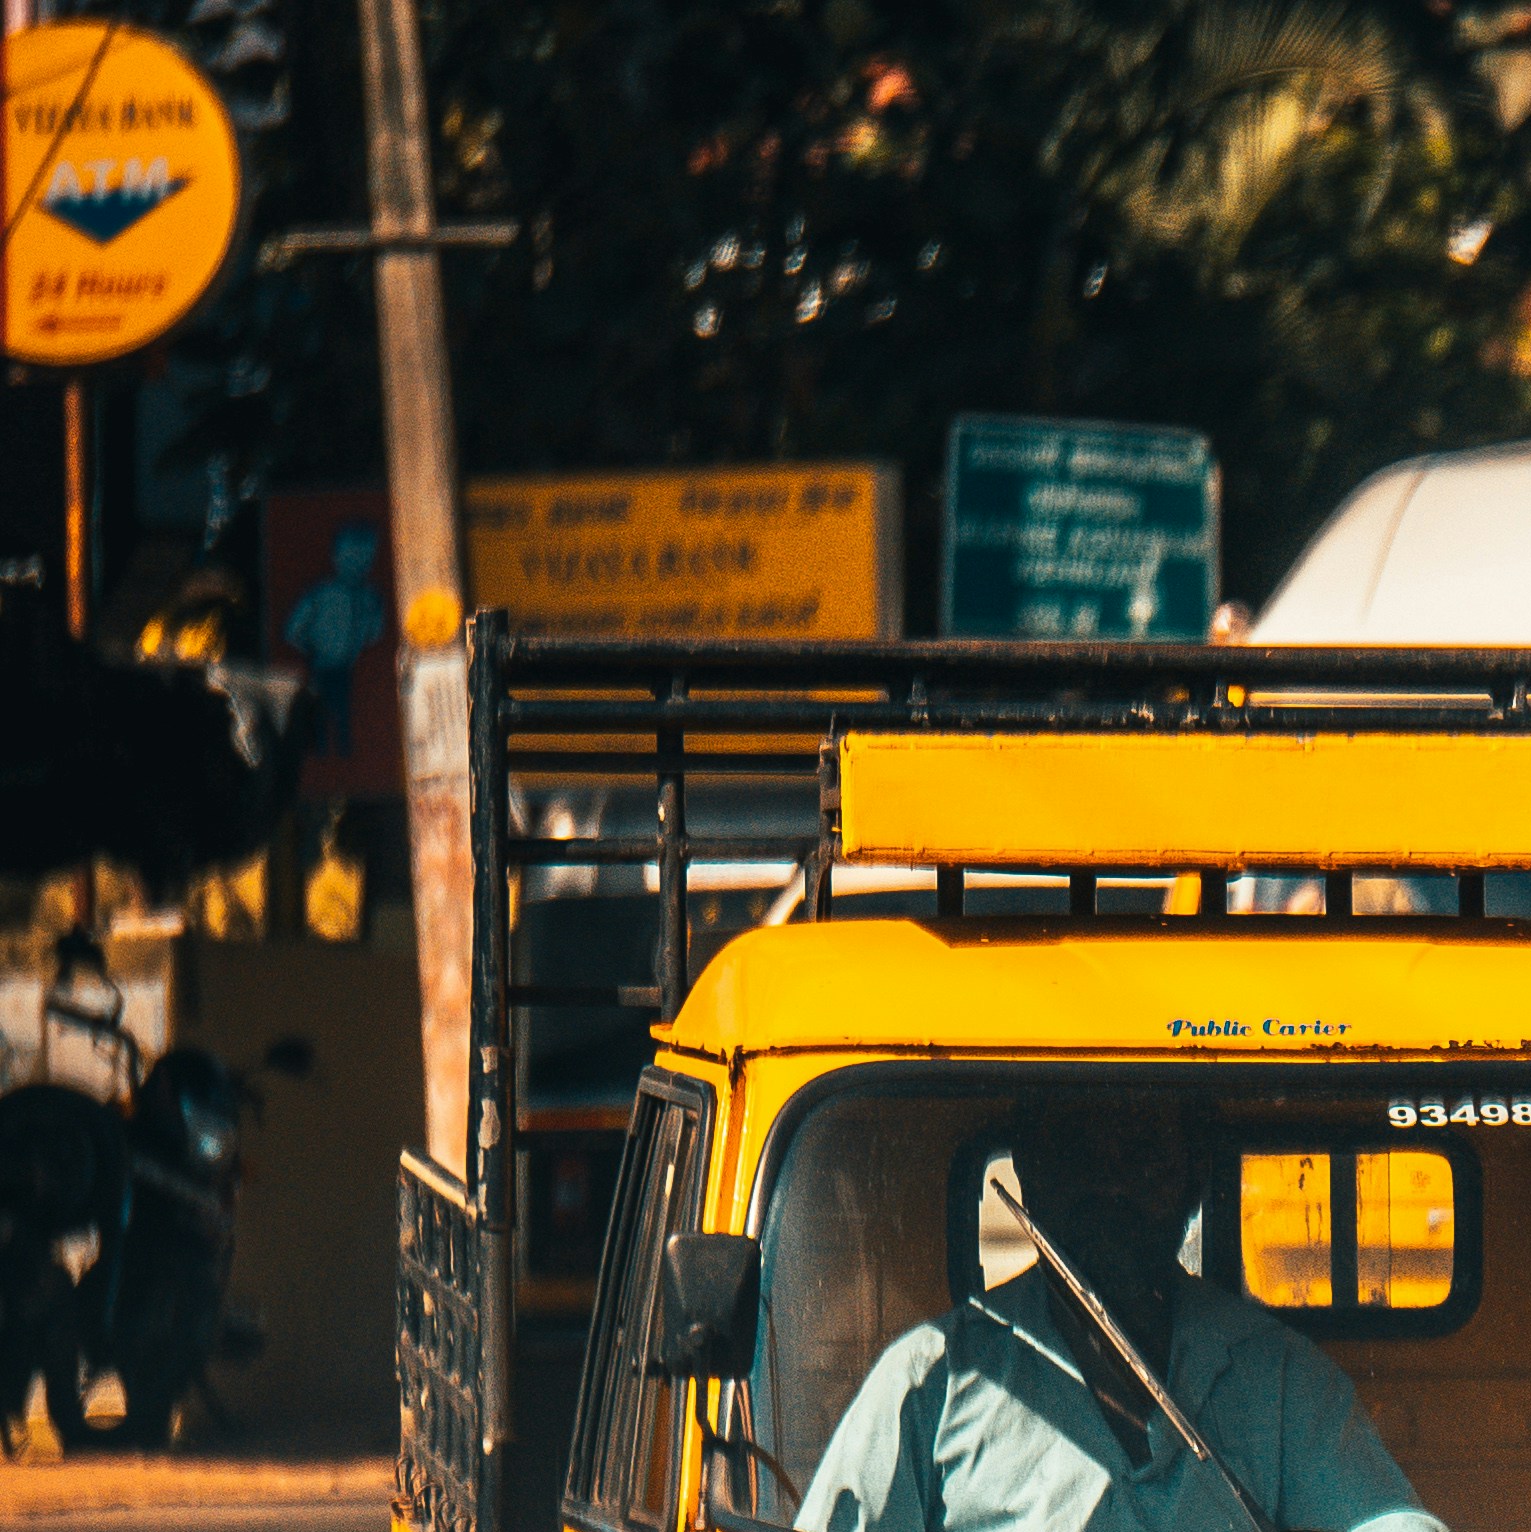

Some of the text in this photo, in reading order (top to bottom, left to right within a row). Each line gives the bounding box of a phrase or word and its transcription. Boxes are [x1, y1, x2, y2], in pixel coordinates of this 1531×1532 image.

[42, 156, 170, 208] ATM
[1167, 1018, 1352, 1038] Public Carier
